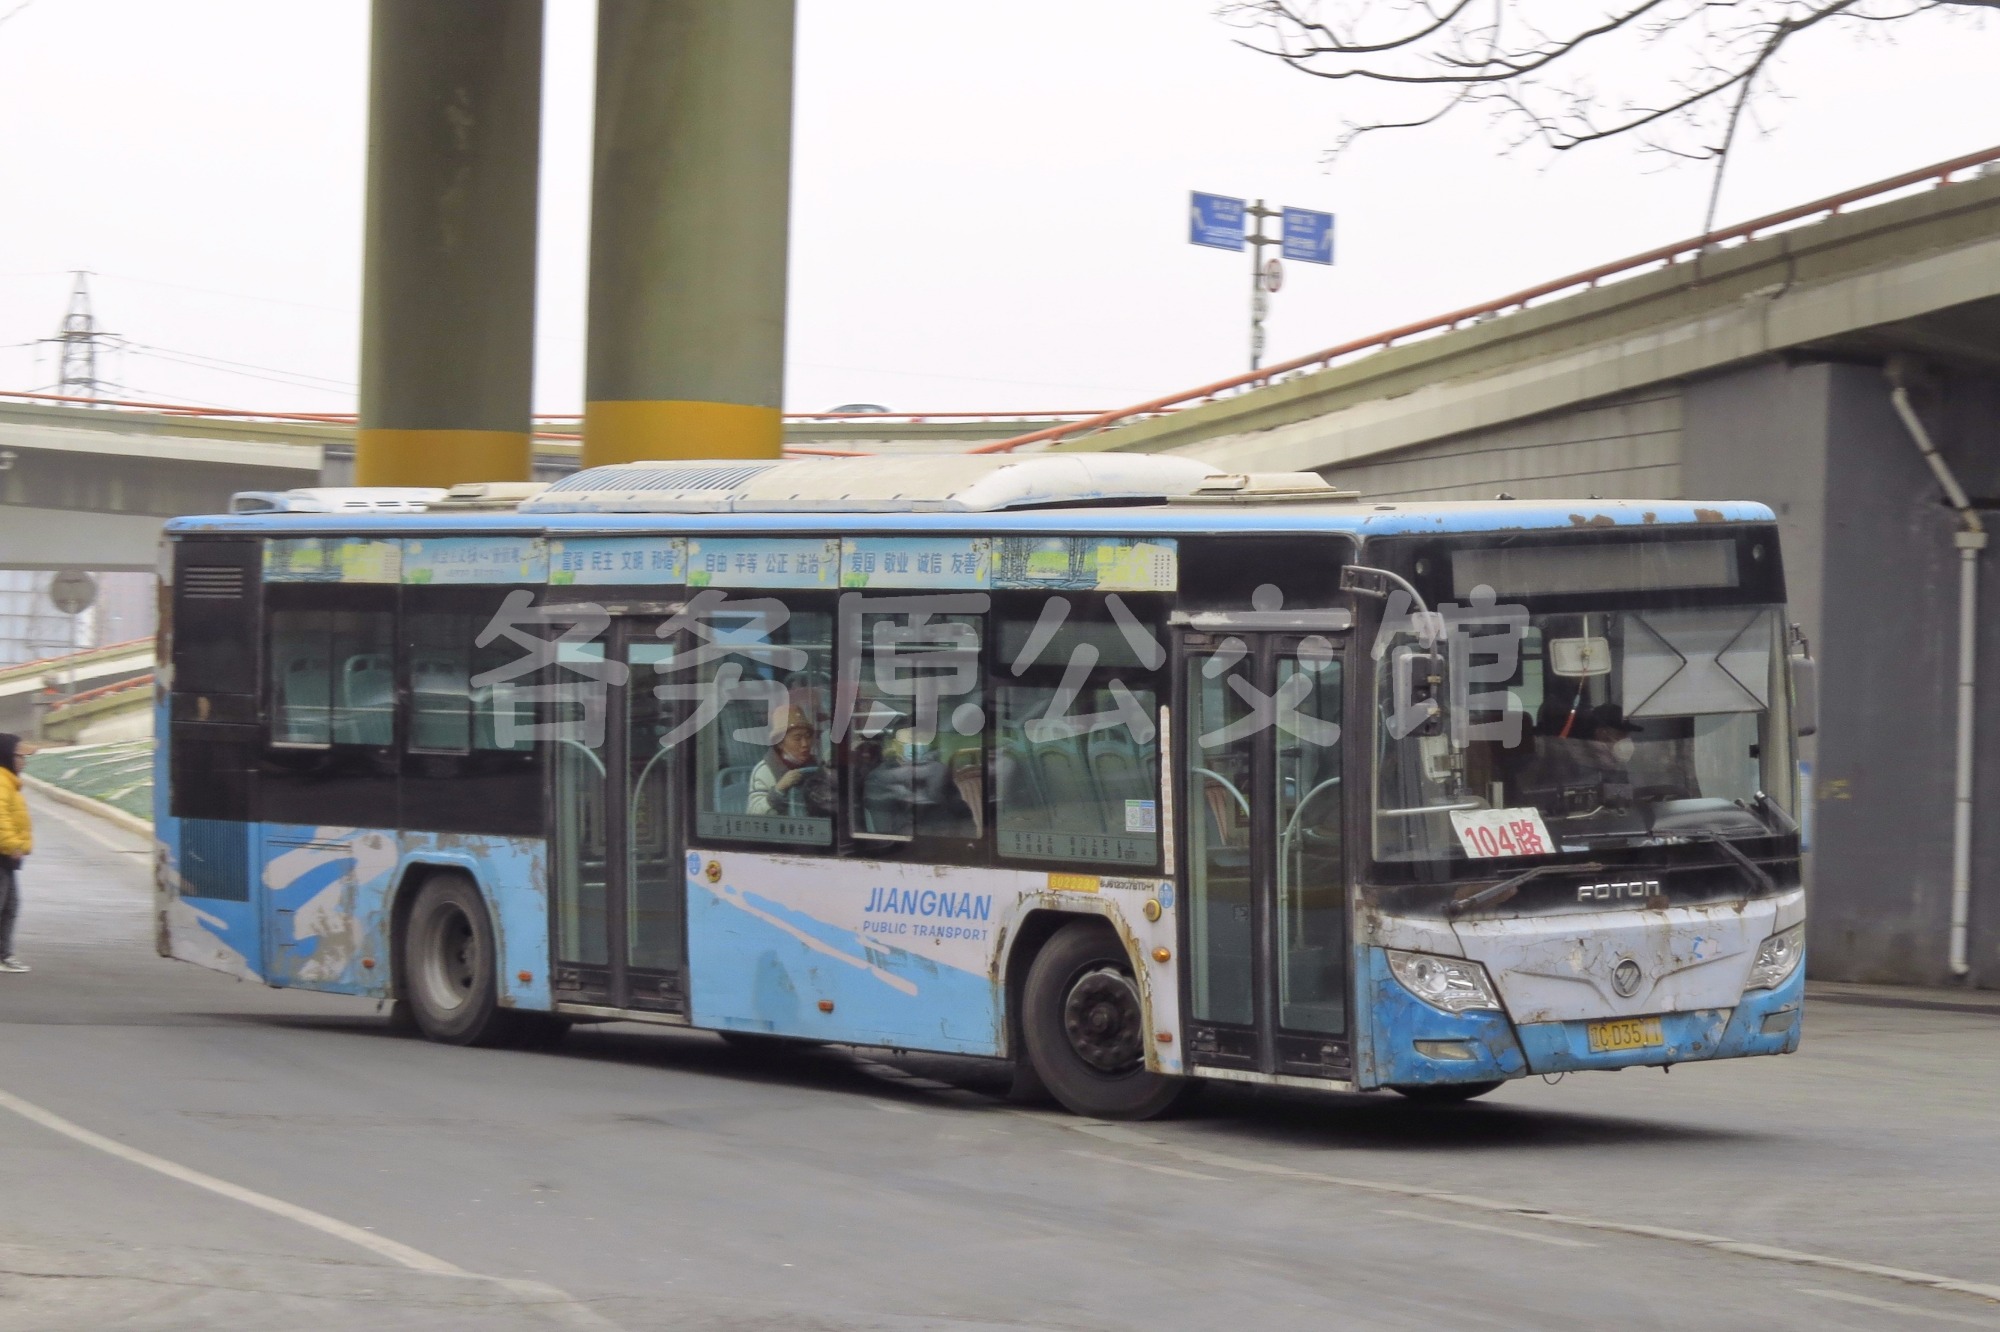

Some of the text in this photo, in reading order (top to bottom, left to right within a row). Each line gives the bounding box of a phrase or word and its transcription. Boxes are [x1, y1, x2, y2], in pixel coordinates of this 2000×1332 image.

[562, 550, 674, 571] 富强 民主 文明 和谐
[706, 553, 819, 574] 自由 平等 公正 法治
[852, 552, 976, 575] 爱国 敬业 诚信 友善
[1464, 819, 1545, 857] 104路
[1578, 881, 1660, 902] FOTON
[864, 887, 992, 921] JIANGNAN
[863, 920, 988, 941] PUBLIC TRANSPORT
